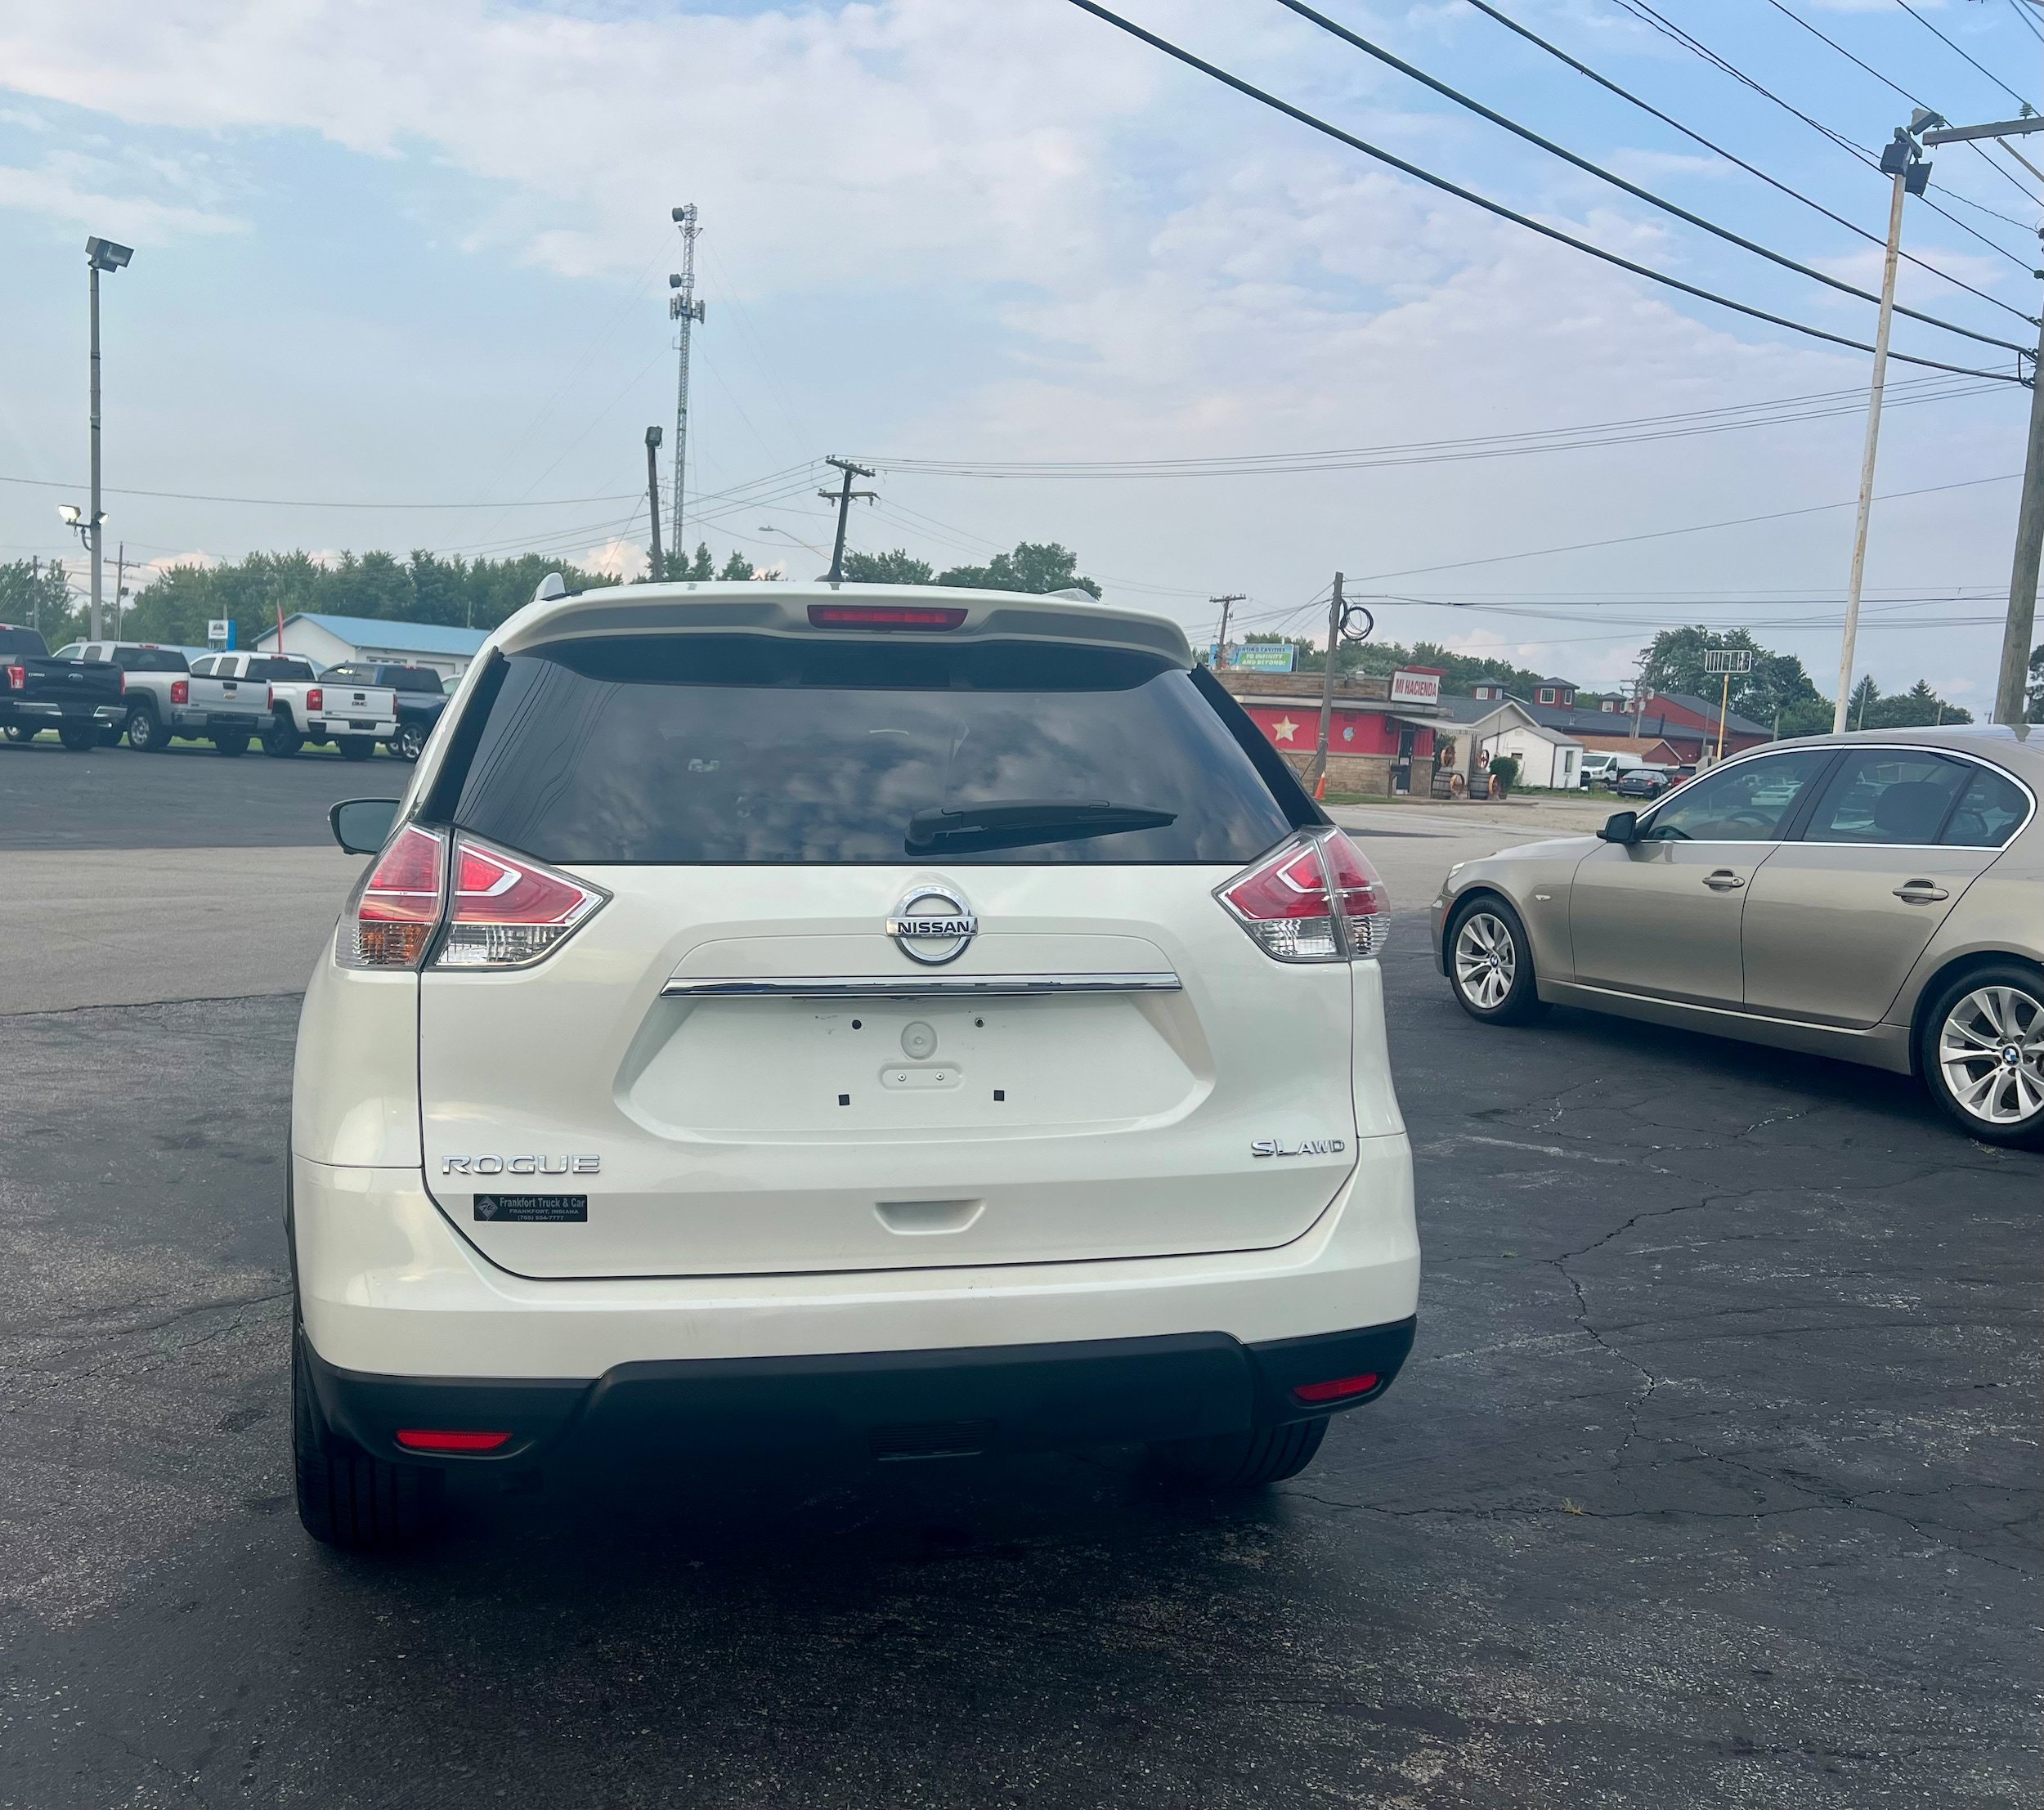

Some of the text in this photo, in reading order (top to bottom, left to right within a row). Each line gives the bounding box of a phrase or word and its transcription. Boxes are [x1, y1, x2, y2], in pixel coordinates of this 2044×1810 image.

[1395, 679, 1437, 697] MI HACIENDA
[898, 921, 969, 934] NISSAN
[1251, 1138, 1345, 1158] SL AWD
[442, 1154, 600, 1176] ROGUE
[500, 1197, 585, 1208] Frankfort Truck & Car
